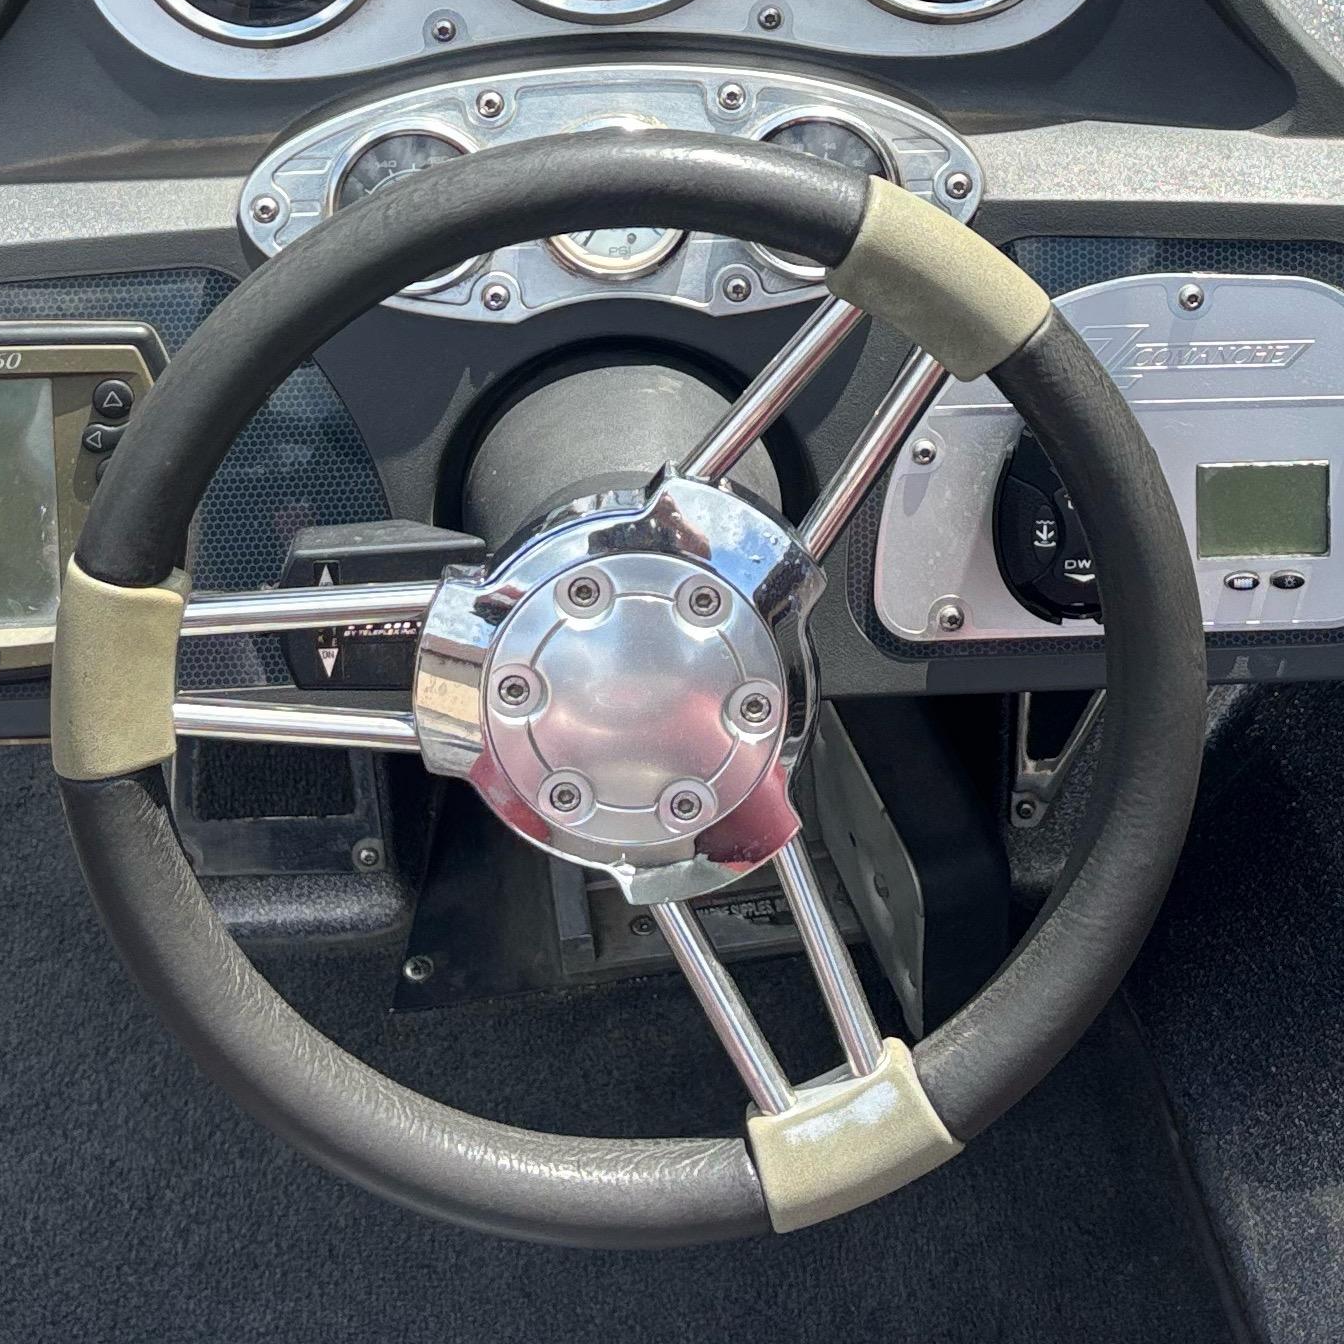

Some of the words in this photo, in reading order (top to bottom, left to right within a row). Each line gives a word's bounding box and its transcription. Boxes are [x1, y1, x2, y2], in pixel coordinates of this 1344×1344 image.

[608, 246, 633, 257] PSI
[1134, 345, 1291, 367] COMANCHE
[1064, 559, 1093, 570] DW
[321, 650, 335, 659] DN
